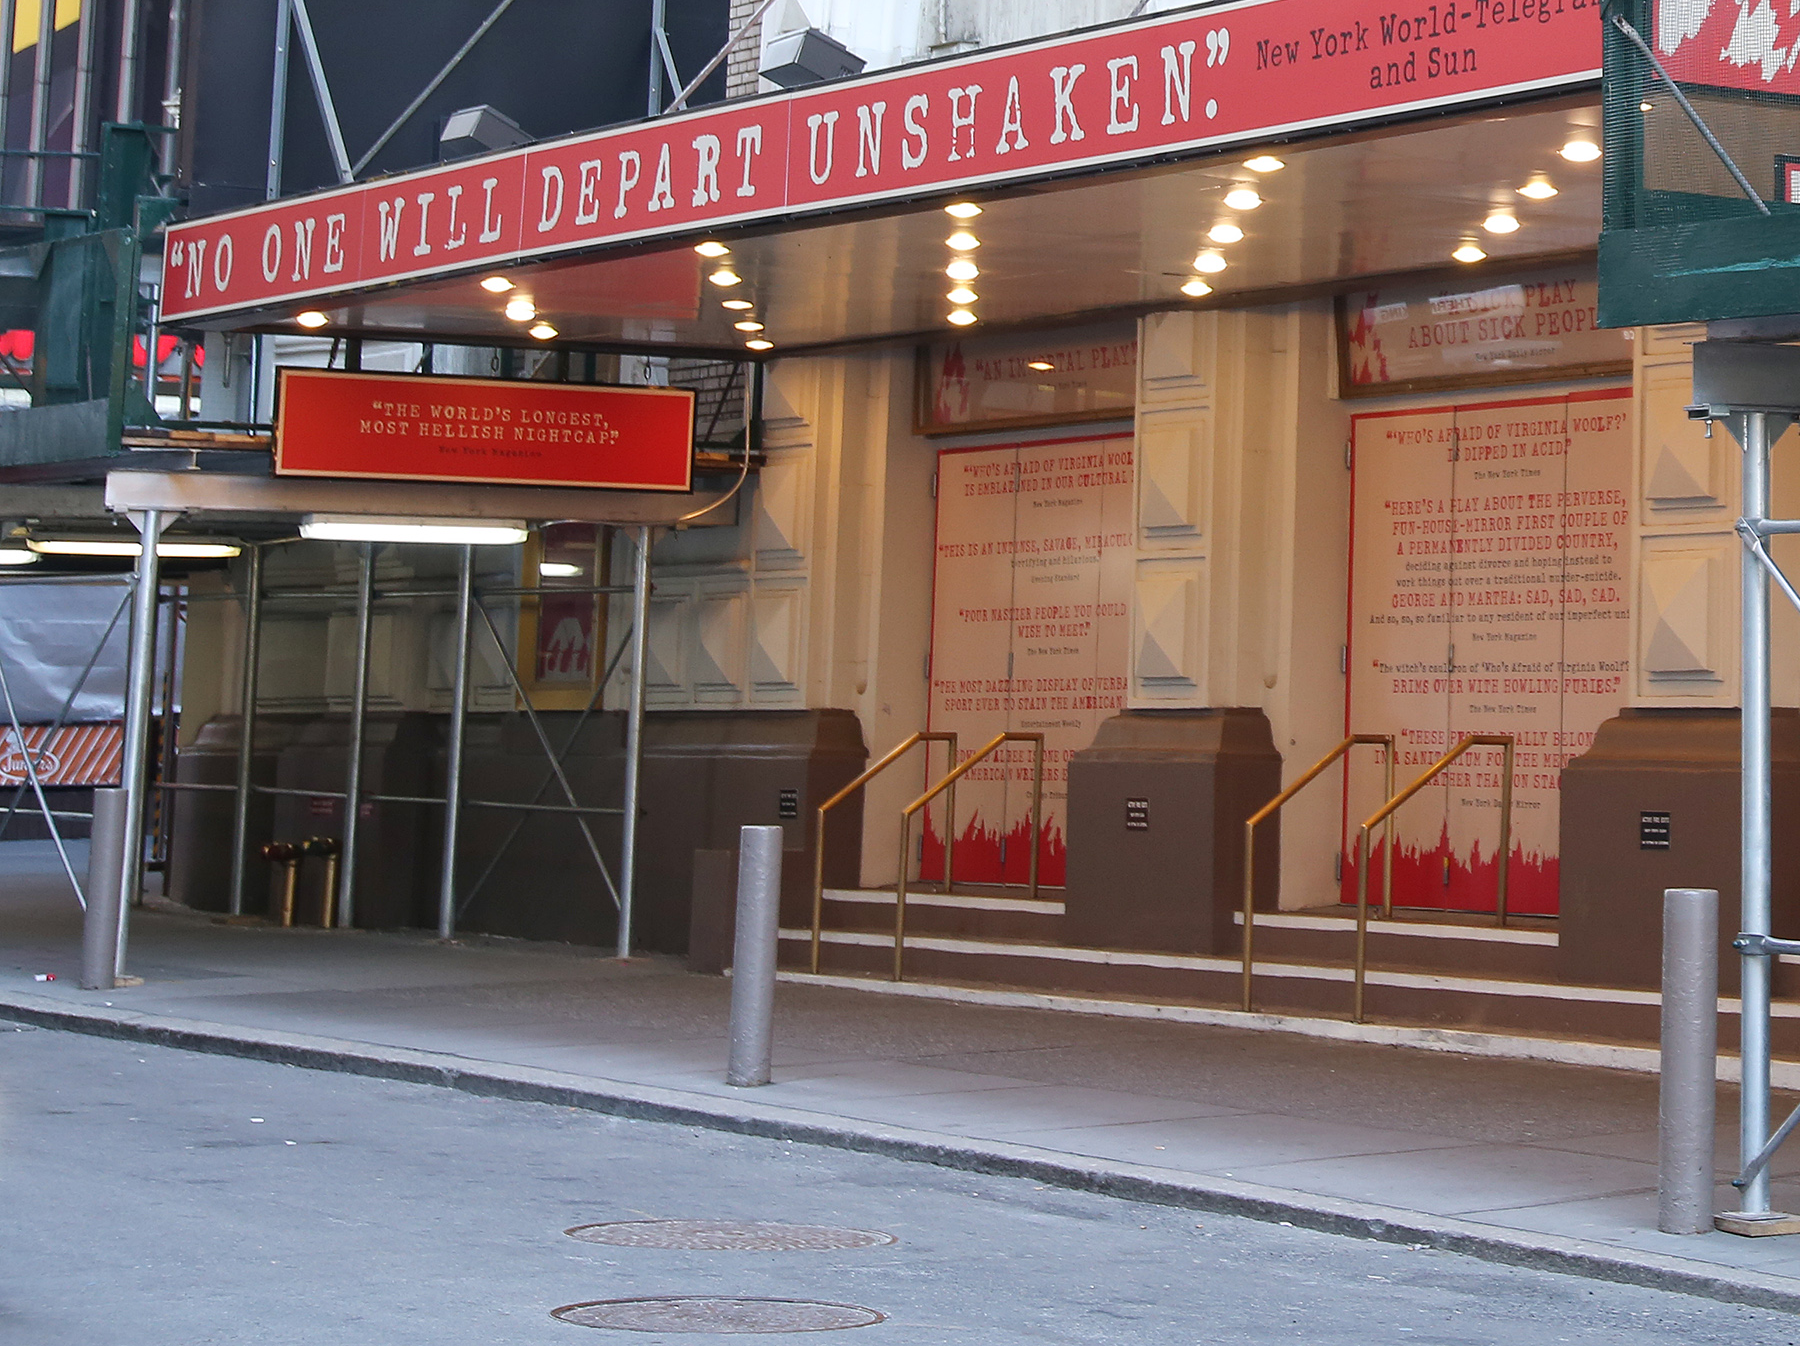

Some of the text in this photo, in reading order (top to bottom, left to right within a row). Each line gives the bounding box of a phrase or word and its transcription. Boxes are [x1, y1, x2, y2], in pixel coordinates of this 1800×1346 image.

[1256, 39, 1300, 70] New
[1310, 21, 1369, 60] York
[1370, 47, 1478, 89] and Sun
[170, 238, 234, 298] "NO
[262, 213, 346, 283] ONE
[379, 176, 504, 264] WILL
[538, 123, 765, 233] DEPART
[1526, 279, 1576, 310] PLAY
[1409, 307, 1598, 348] ABOUT SICK PEOPL
[372, 400, 609, 430] "THE WORLD'S LONGEST,
[360, 420, 409, 436] MOST
[420, 424, 504, 440] HELLISH
[1438, 426, 1482, 443] AFRAID
[1487, 425, 1500, 440] OF
[1507, 420, 1567, 438] VIRGINIA
[463, 446, 486, 456] York
[1464, 444, 1508, 462] DIPPED
[1513, 443, 1526, 458] IN
[1058, 455, 1104, 470] VIRGINIA
[1474, 468, 1540, 480] The New York Times
[1385, 490, 1627, 515] "HERE'S A PLAY ABOUT THE PERVERSE,
[1393, 511, 1629, 536] FUN-HOUSE-MIRROR FIRST COUPLE OF
[1397, 533, 1618, 555] A PERMANENTLY DIVIDED COUNTRY,
[1392, 587, 1620, 608] GEORGE AND MARTHA: SAD, SAD, SAD.
[1035, 605, 1069, 620] PEOPLE
[1074, 604, 1092, 618] YOU
[1096, 603, 1126, 617] COULD
[1018, 625, 1041, 639] WISH
[1045, 625, 1056, 638] TO
[1393, 679, 1429, 694] BRIMS
[1434, 679, 1463, 694] OVER
[1468, 679, 1499, 693] WITH
[1504, 678, 1559, 693] HOWLING
[945, 696, 1122, 711] SPORT EVER STAIN THE AMERICAN
